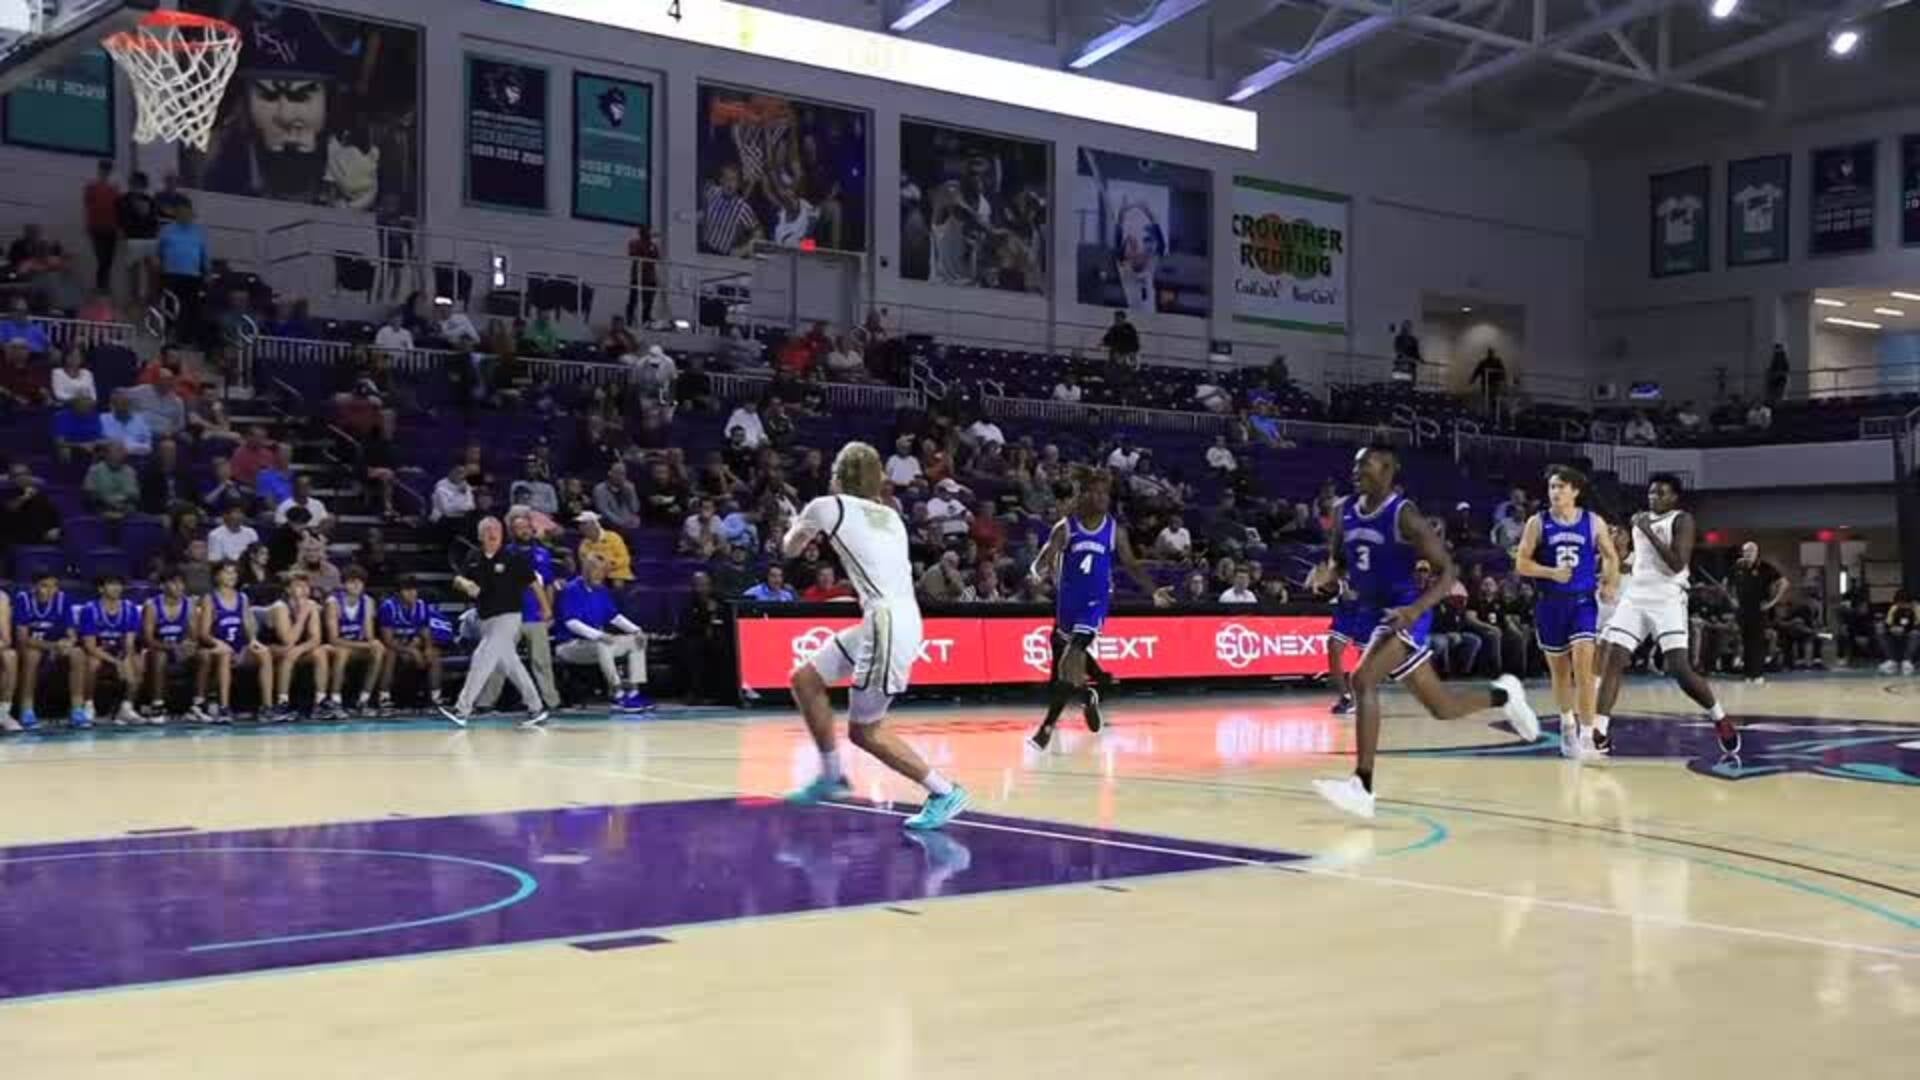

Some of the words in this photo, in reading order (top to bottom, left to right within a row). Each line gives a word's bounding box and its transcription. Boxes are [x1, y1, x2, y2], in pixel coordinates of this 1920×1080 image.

[1232, 213, 1343, 254] CROWTHER
[1240, 243, 1332, 278] ROOFING
[1080, 554, 1093, 575] 4
[1356, 545, 1371, 572] 3
[1555, 545, 1580, 568] 25
[1023, 627, 1053, 671] S
[1216, 625, 1261, 668] SC
[1263, 634, 1329, 656] NEXT
